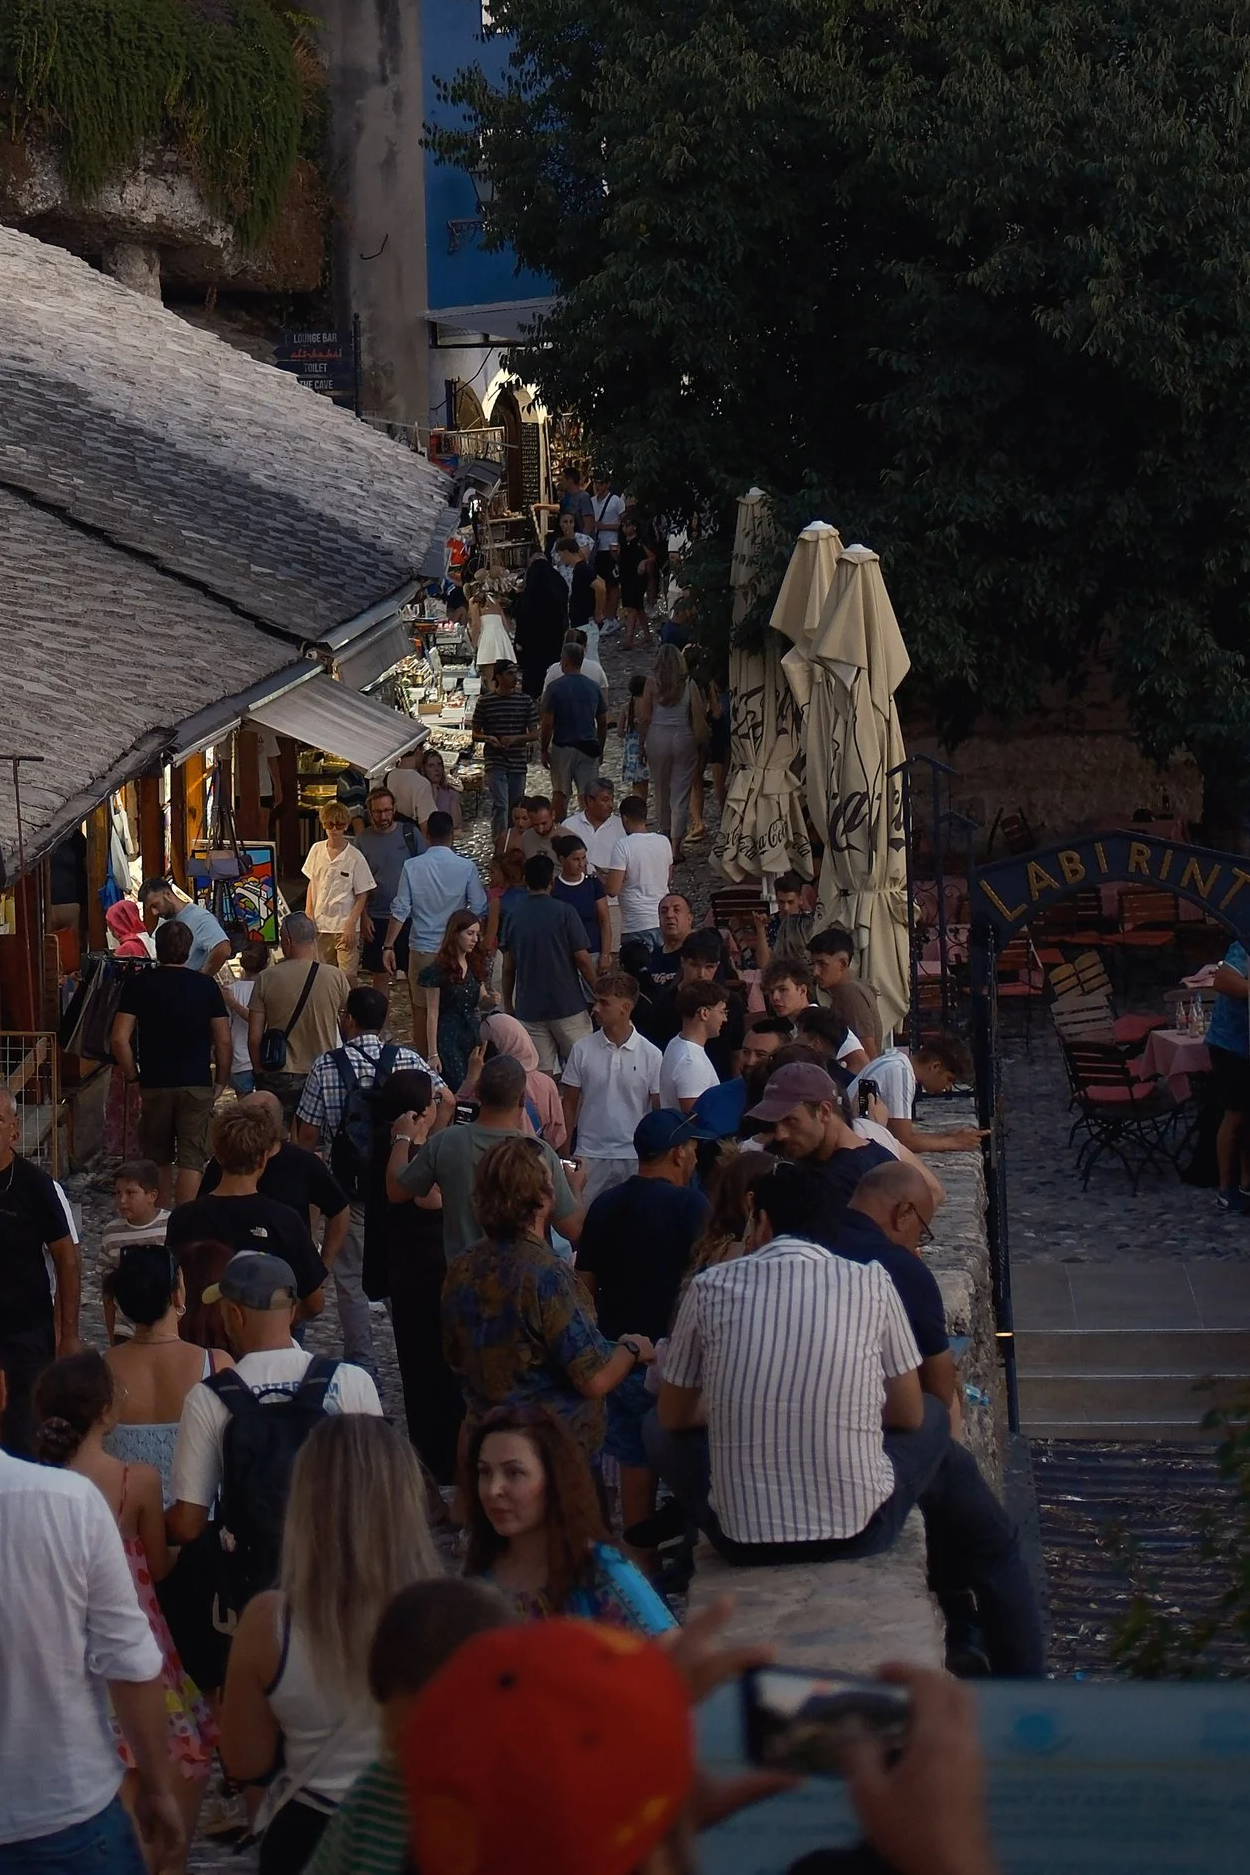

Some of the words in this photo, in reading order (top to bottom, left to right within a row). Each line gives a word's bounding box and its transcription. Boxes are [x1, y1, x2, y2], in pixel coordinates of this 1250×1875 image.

[293, 332, 321, 344] LOUNGE
[322, 332, 338, 343] BAR
[303, 363, 328, 373] TOILET
[314, 379, 334, 389] CAVE
[977, 840, 1250, 923] LABIRINT
